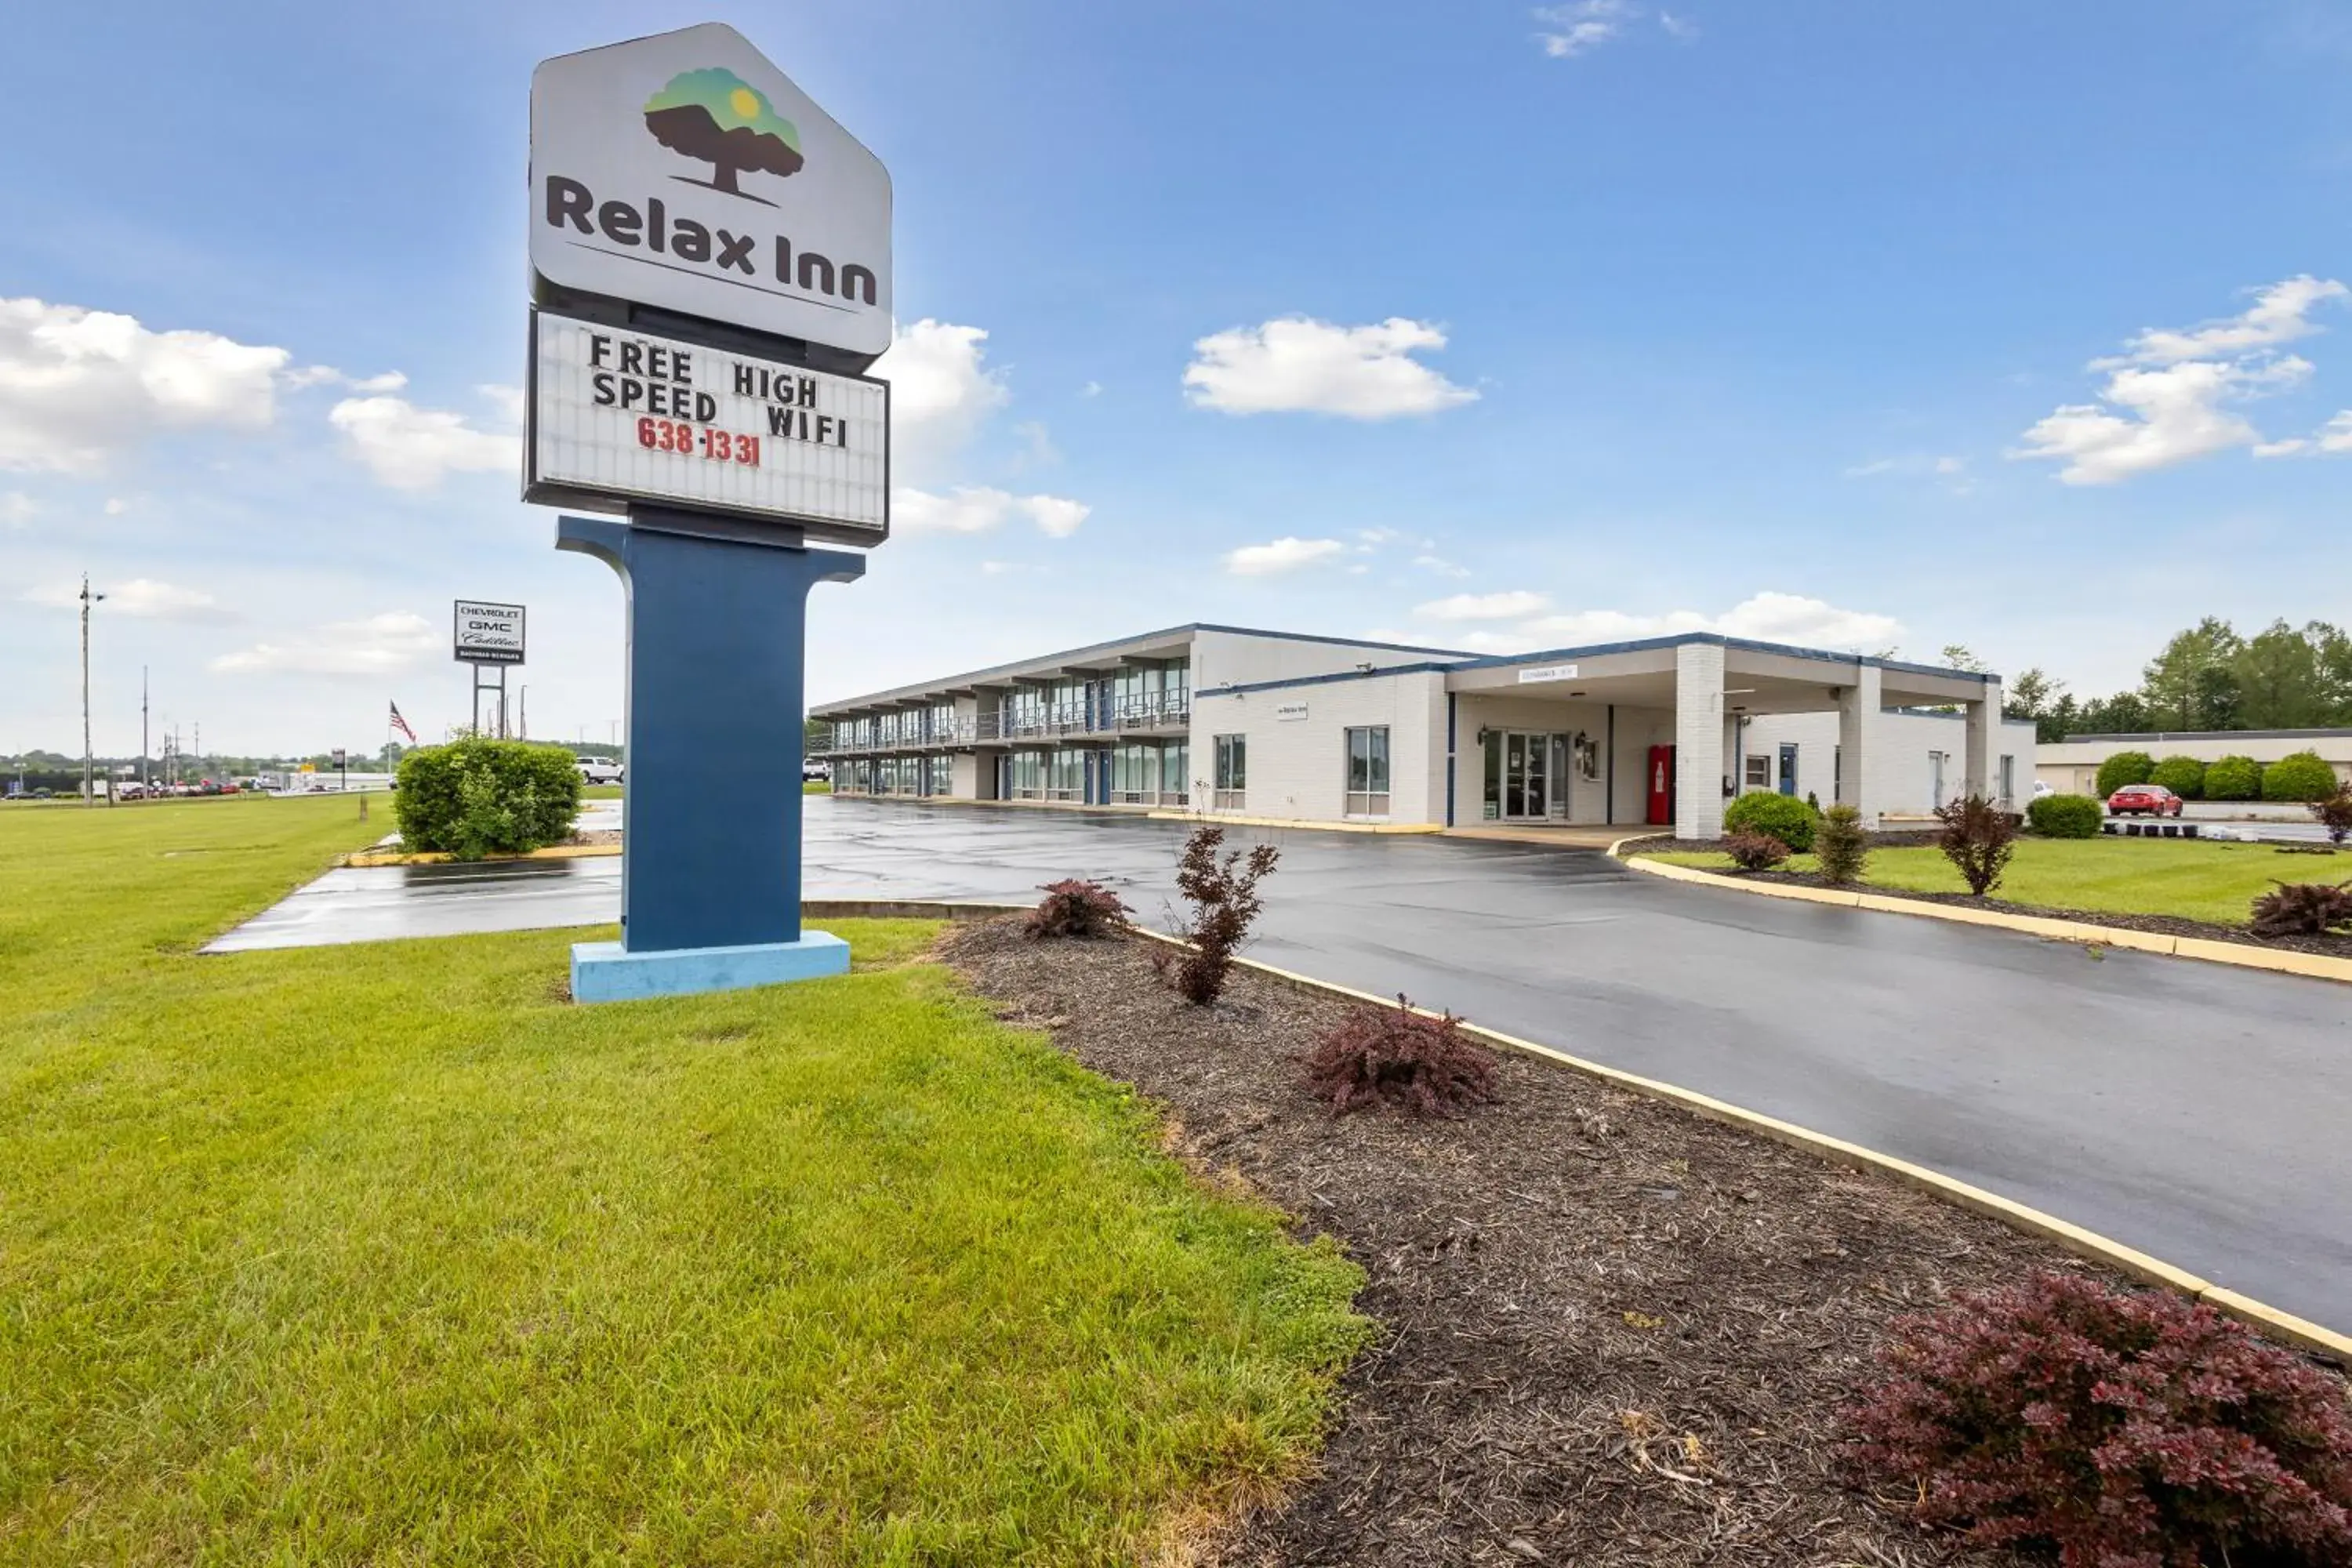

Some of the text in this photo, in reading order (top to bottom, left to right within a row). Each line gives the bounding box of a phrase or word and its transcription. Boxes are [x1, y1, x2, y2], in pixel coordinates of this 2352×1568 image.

[546, 176, 877, 305] Relax Inn
[592, 335, 816, 408] FREE HIGH
[593, 373, 846, 448] SPEED WIFI
[637, 417, 760, 466] 638-1331
[461, 607, 518, 618] CHEVROLET
[469, 621, 512, 632] GMC
